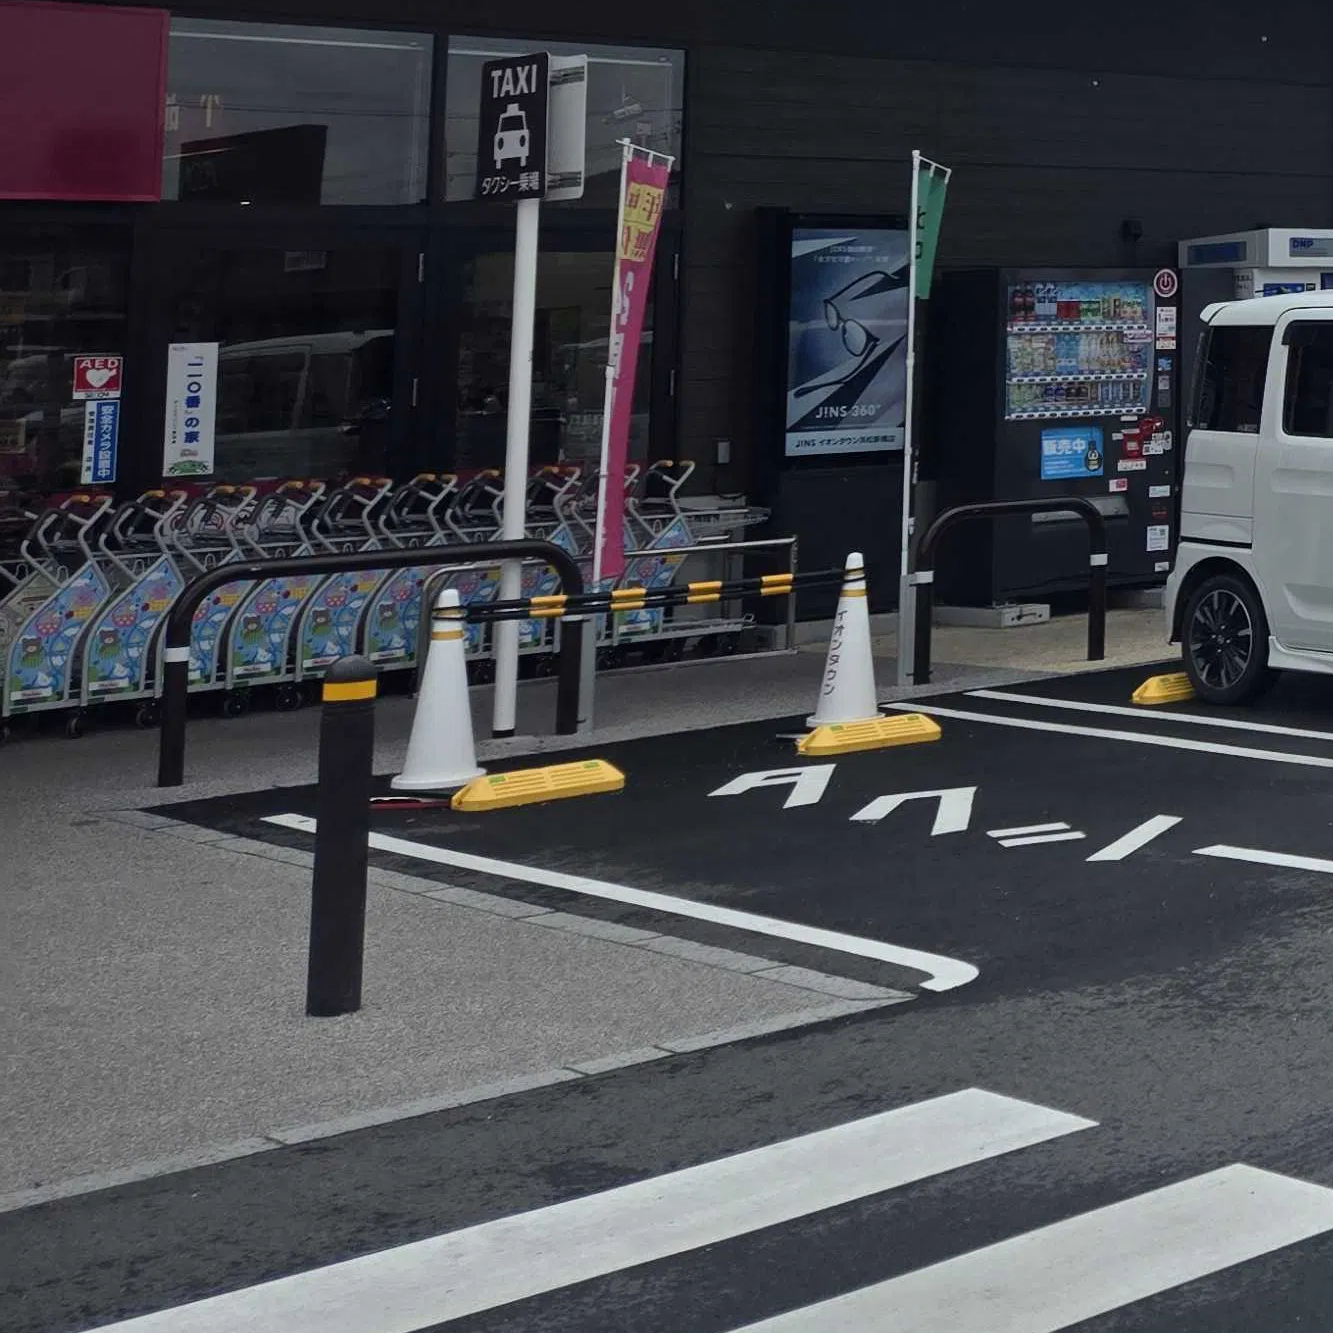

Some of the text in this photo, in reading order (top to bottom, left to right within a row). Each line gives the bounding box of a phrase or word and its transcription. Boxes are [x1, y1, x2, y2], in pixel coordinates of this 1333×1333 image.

[490, 64, 538, 99] TAXI
[1292, 239, 1314, 249] DNP
[79, 358, 119, 369] AED
[815, 405, 847, 419] JINS
